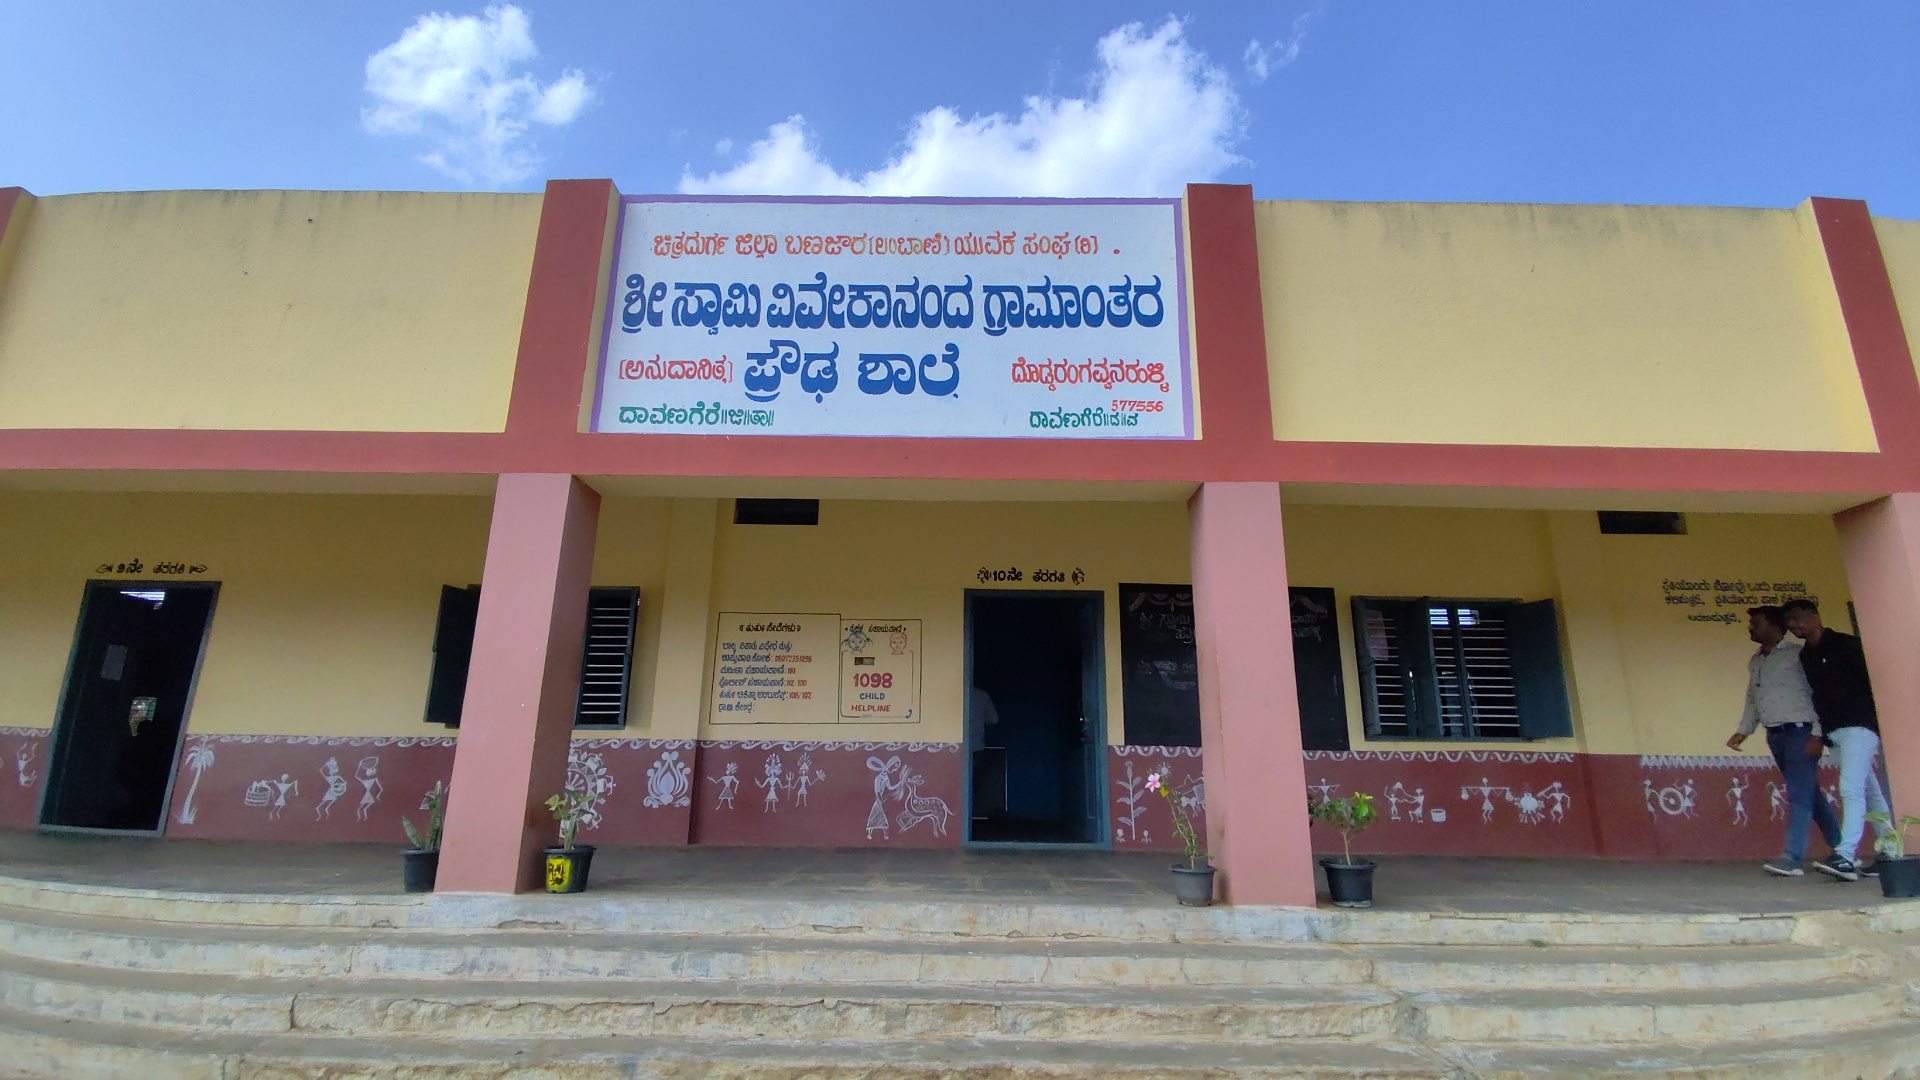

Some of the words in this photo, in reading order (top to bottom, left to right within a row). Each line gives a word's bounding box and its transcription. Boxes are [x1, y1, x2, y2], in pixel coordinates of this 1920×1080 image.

[654, 231, 729, 259] ಚಿತ್ರದುರ್ಗ
[735, 233, 778, 259] ಜಿಲ್ಲಾ
[954, 231, 1017, 256] ಯುವಕ
[621, 273, 667, 333] ಶ್ರೀ
[671, 281, 761, 336] ಸ್ವಾಮಿ
[766, 271, 974, 329] ವಿವೇಕಾನಂದ
[982, 274, 1164, 337] ಗ್ರಾಮಾಂತರ
[743, 338, 840, 404] ಪ್ರೌಢ
[857, 342, 960, 399] ಶಾಲೆ
[1111, 400, 1165, 413] 577556
[152, 561, 185, 575] ತರಗತಿ
[1032, 568, 1066, 583] ತರಗತಿ
[853, 672, 894, 689] 1098
[859, 692, 886, 701] CHILD
[851, 704, 892, 713] HELPLINE
